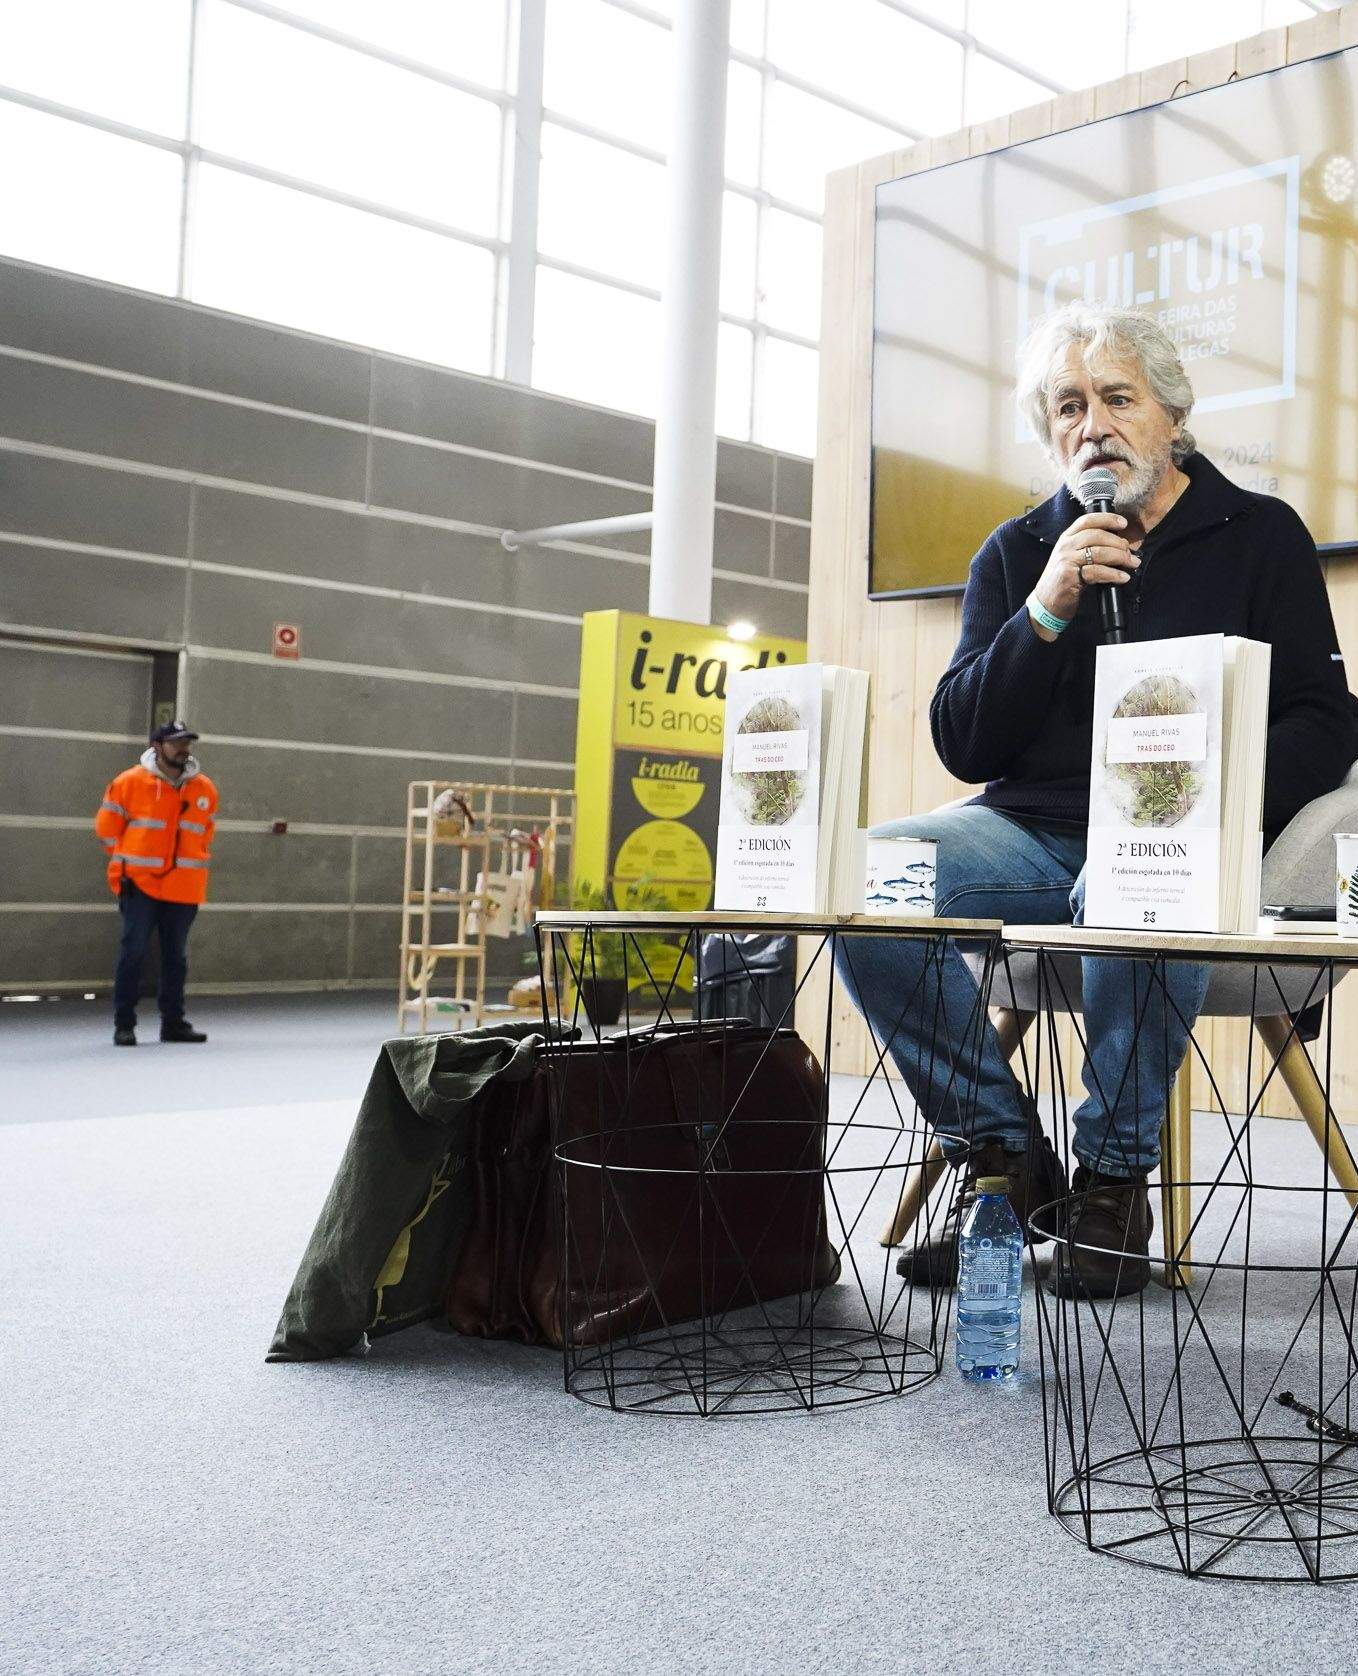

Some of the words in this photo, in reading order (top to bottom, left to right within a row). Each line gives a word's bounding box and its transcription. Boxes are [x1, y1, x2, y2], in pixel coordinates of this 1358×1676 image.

[1043, 223, 1264, 311] CULTUR
[1158, 303, 1202, 327] FEIRA
[1204, 295, 1238, 318] DAS
[1163, 316, 1238, 345] ULTURAS
[1178, 337, 1231, 362] LEGAS
[1224, 441, 1273, 468] 2024
[628, 700, 656, 728] 15
[661, 707, 723, 735] anos
[1133, 729, 1160, 738] MANUEL
[1160, 727, 1181, 736] RIVAS
[1136, 744, 1153, 752] TRAS
[738, 838, 747, 851] 2ª
[749, 835, 792, 851] EDICIÓN
[1116, 843, 1127, 857] 2ª
[1130, 840, 1187, 858] EDICIÓN
